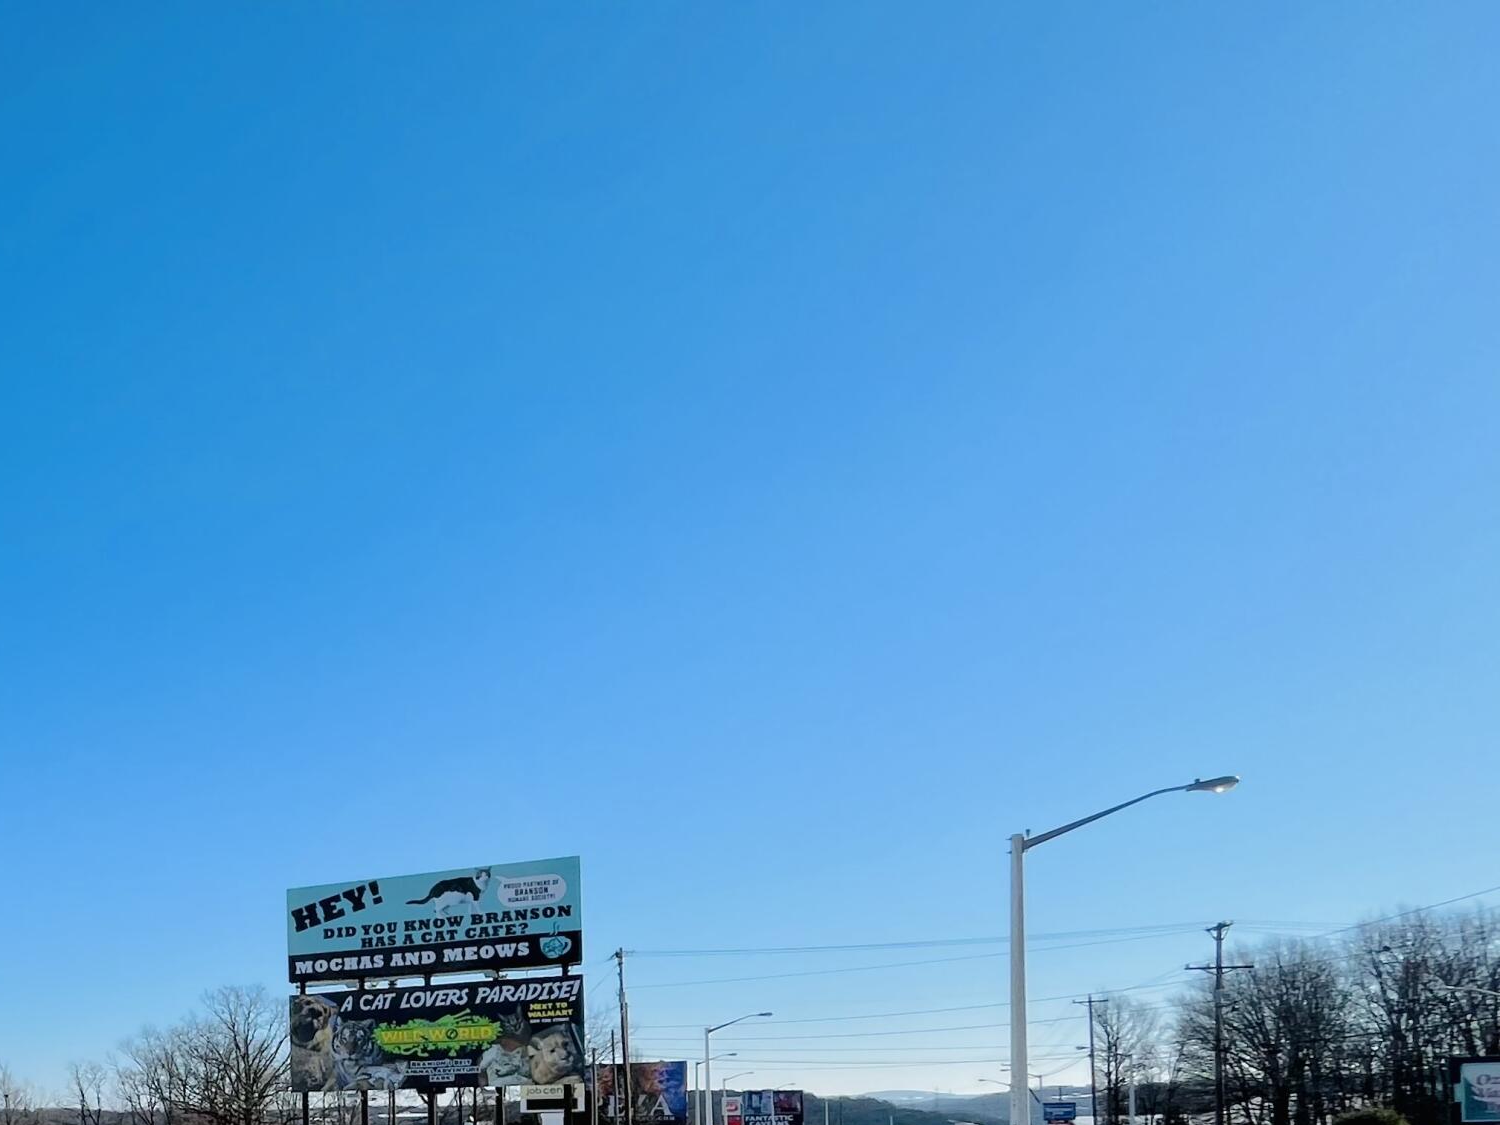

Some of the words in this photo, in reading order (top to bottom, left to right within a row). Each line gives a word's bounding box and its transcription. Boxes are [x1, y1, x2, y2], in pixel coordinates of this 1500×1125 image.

[291, 880, 383, 932] HEY!
[323, 926, 357, 939] DID
[361, 921, 398, 935] YOU
[404, 916, 464, 932] KNOW
[471, 905, 572, 925] BRANSON
[361, 935, 396, 948] HAS
[403, 933, 414, 944] A
[421, 930, 458, 943] CAT
[465, 922, 529, 940] CAFE?
[295, 955, 385, 974] MOCHAS
[390, 951, 437, 967] AND
[443, 942, 530, 962] MEOWS
[340, 995, 353, 1012] A
[360, 992, 396, 1011] CAT
[400, 988, 468, 1009] LOVERS
[475, 980, 580, 1004] PARADISE!
[529, 1003, 553, 1011] NEXT
[527, 1009, 574, 1018] WALMART
[381, 1029, 424, 1043] WILD
[429, 1027, 493, 1042] WORLD
